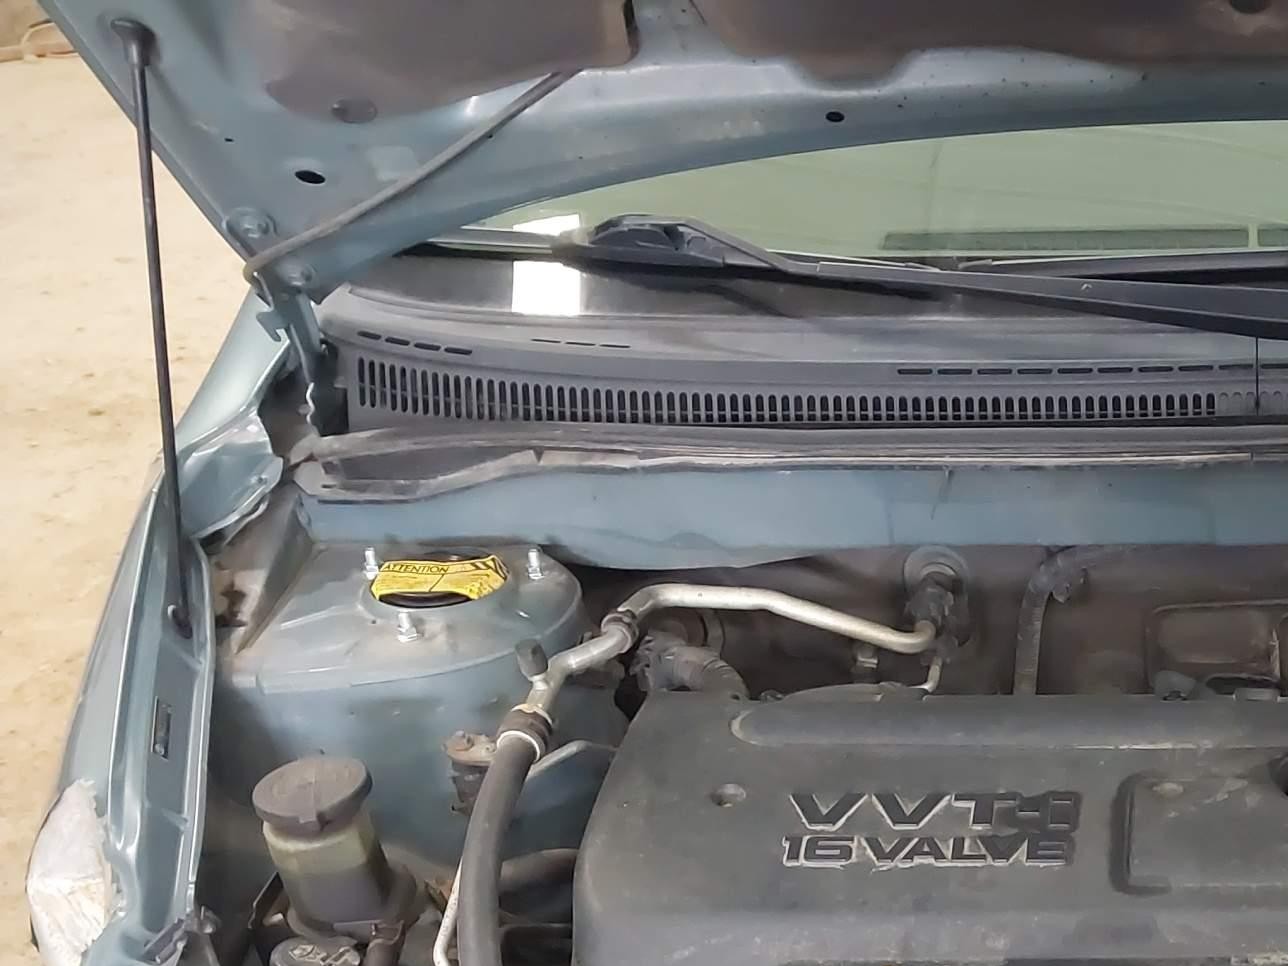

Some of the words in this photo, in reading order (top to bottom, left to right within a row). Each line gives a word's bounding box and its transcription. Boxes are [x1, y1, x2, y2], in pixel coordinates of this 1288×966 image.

[384, 563, 449, 574] ATTENTION
[782, 834, 857, 867] 16
[860, 835, 1071, 867] VALVE
